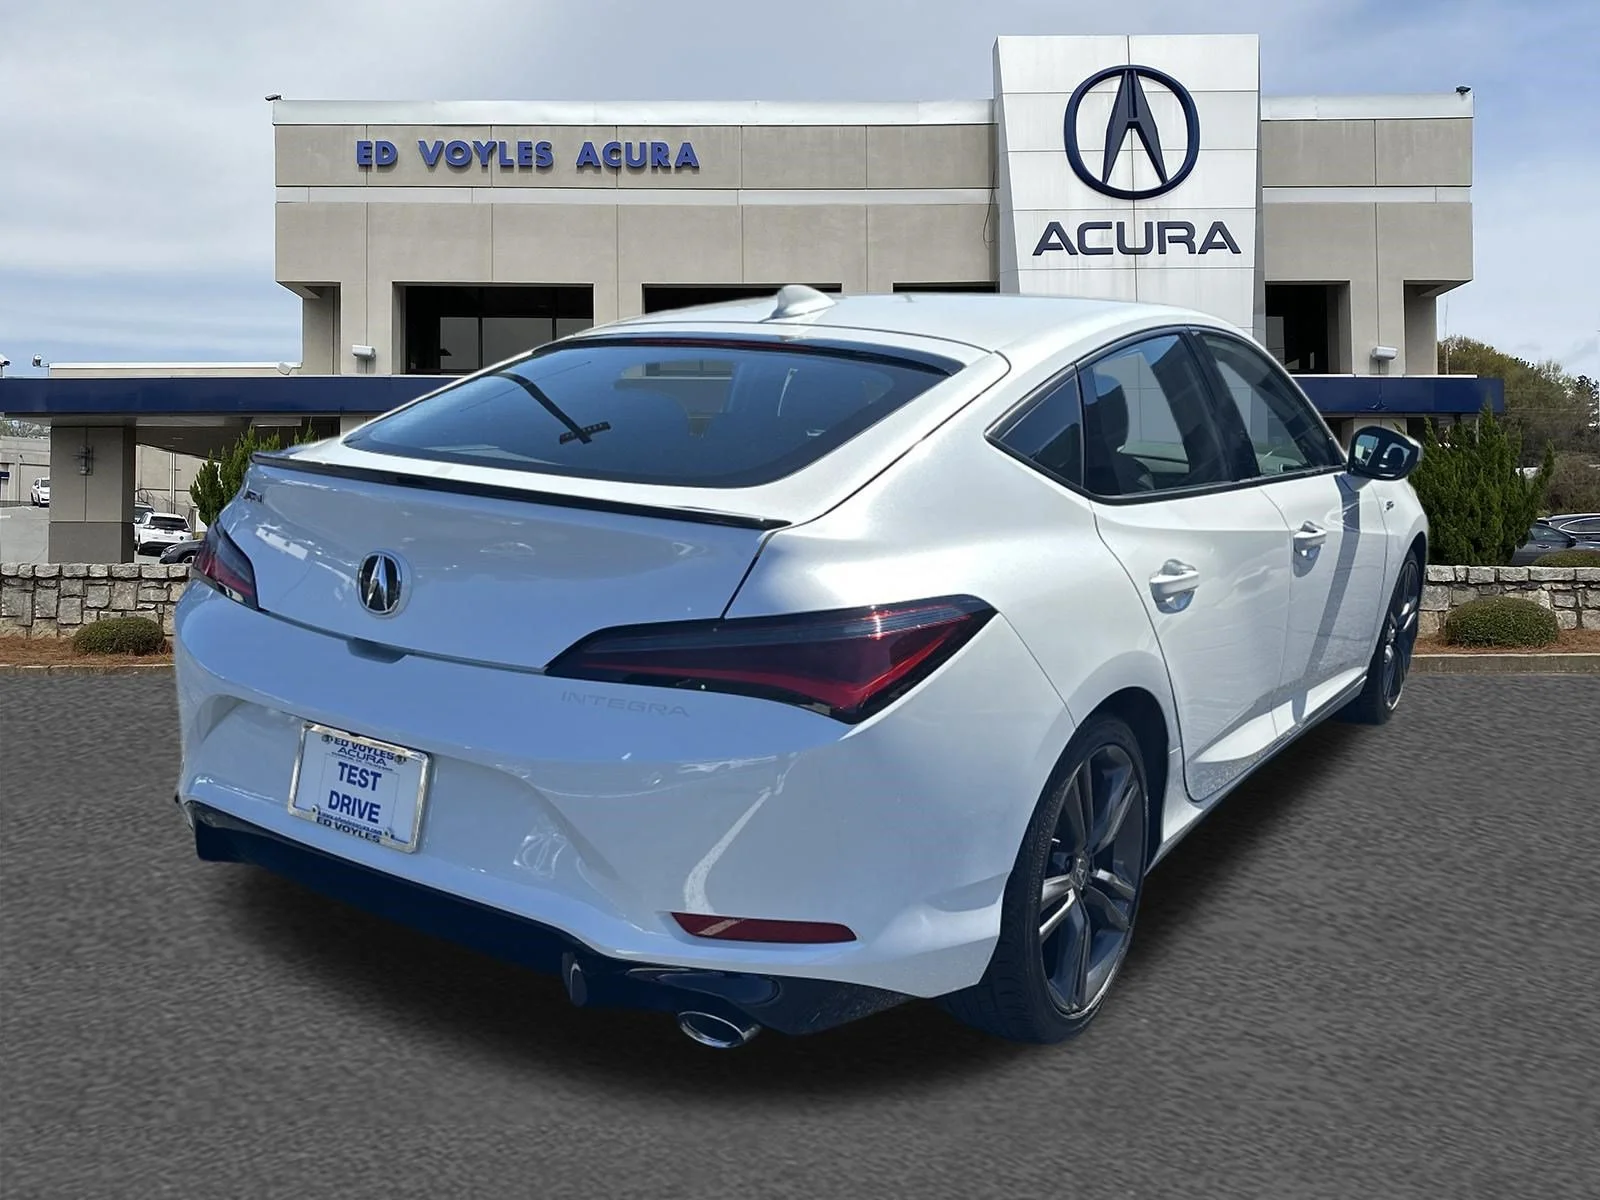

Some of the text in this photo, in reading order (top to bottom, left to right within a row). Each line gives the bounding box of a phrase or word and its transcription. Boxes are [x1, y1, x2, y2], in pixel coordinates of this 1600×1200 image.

[356, 140, 700, 169] ED VOYLES ACURA
[1032, 221, 1242, 256] ACURA
[561, 691, 690, 718] INTEGRA
[334, 738, 394, 760] ED VOYLES
[337, 747, 387, 766] ACURA
[338, 761, 382, 791] TEST
[328, 790, 381, 824] DRIVE
[316, 817, 332, 827] ED
[333, 823, 380, 843] VOYLES
